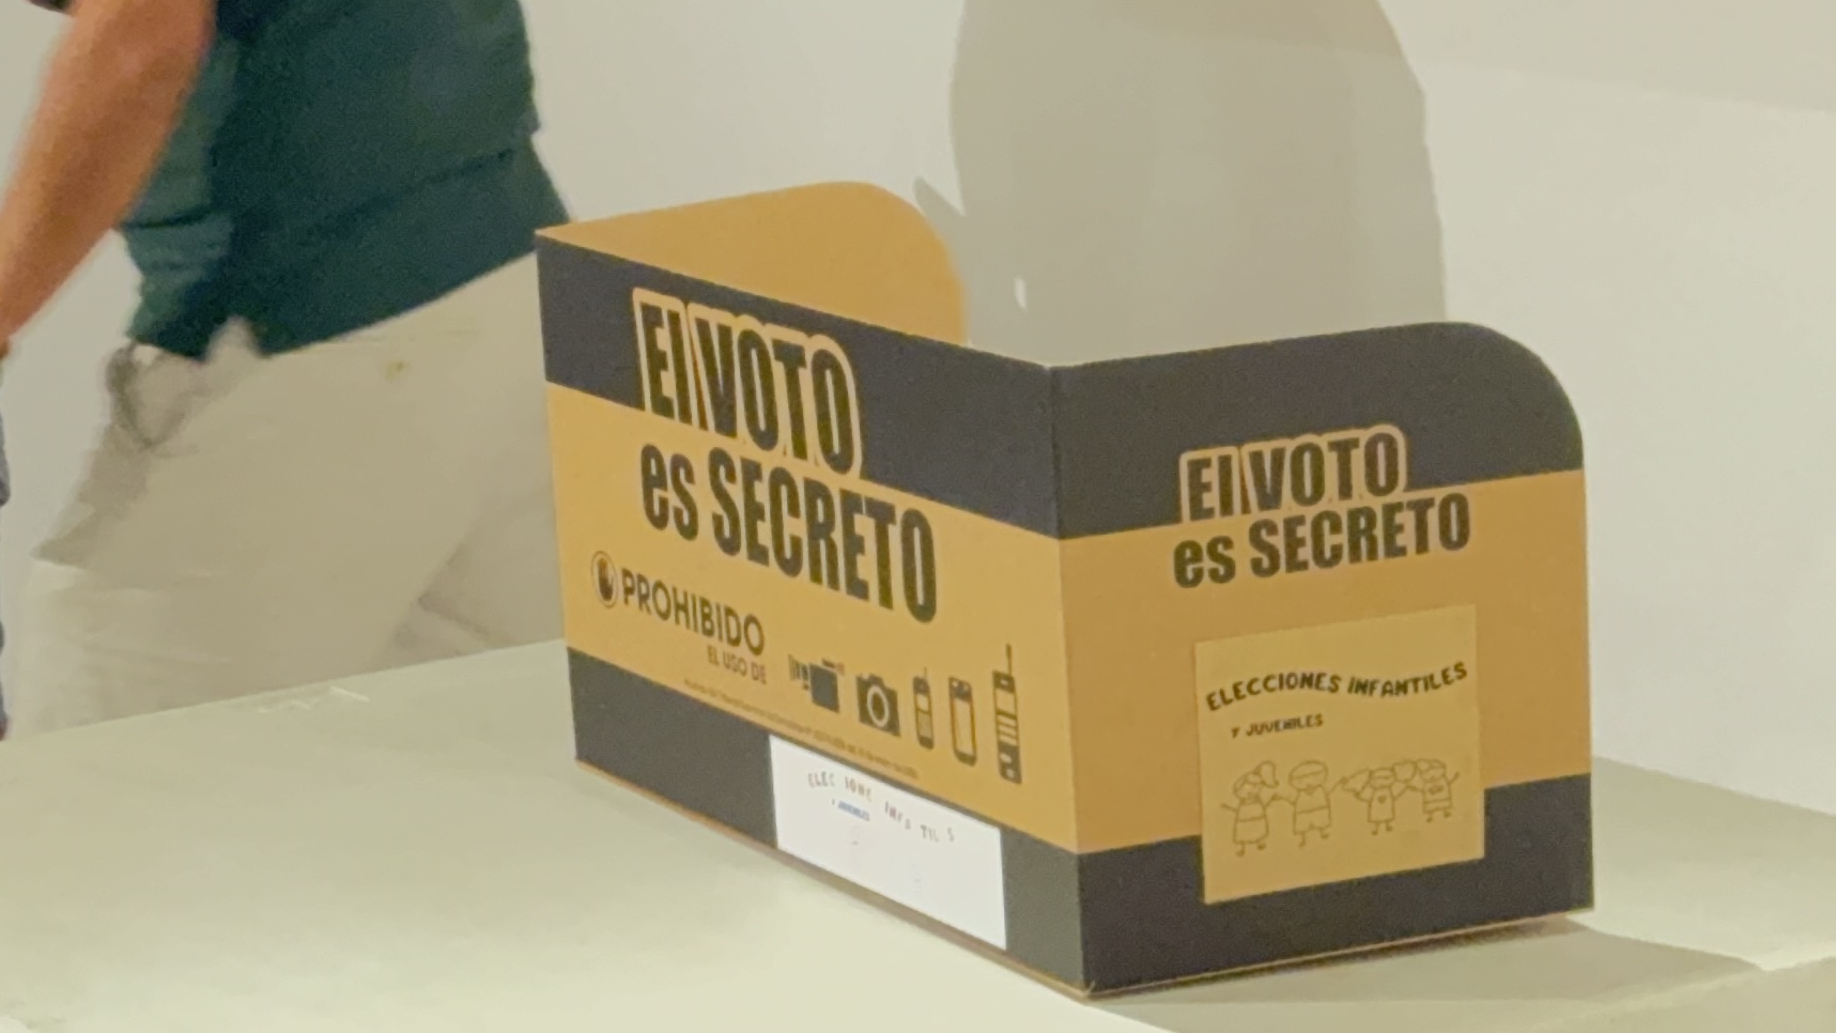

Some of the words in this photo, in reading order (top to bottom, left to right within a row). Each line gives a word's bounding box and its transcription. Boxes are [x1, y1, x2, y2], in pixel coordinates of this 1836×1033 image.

[640, 301, 692, 425] El
[694, 316, 854, 475] VOTO
[1187, 454, 1234, 521] El
[1249, 432, 1399, 512] VOTO
[640, 443, 699, 541] es
[708, 446, 937, 624] SECRETO
[1173, 535, 1236, 589] es
[1248, 492, 1471, 578] SECRETO
[621, 567, 765, 656] PROHIBIDO
[707, 645, 721, 666] EL
[723, 651, 748, 677] USO
[750, 661, 767, 685] DE
[1206, 672, 1342, 711] ELECCIONES
[1347, 661, 1468, 698] INFANTILES
[1231, 726, 1241, 738] Y
[1246, 713, 1324, 737] JUVENILES
